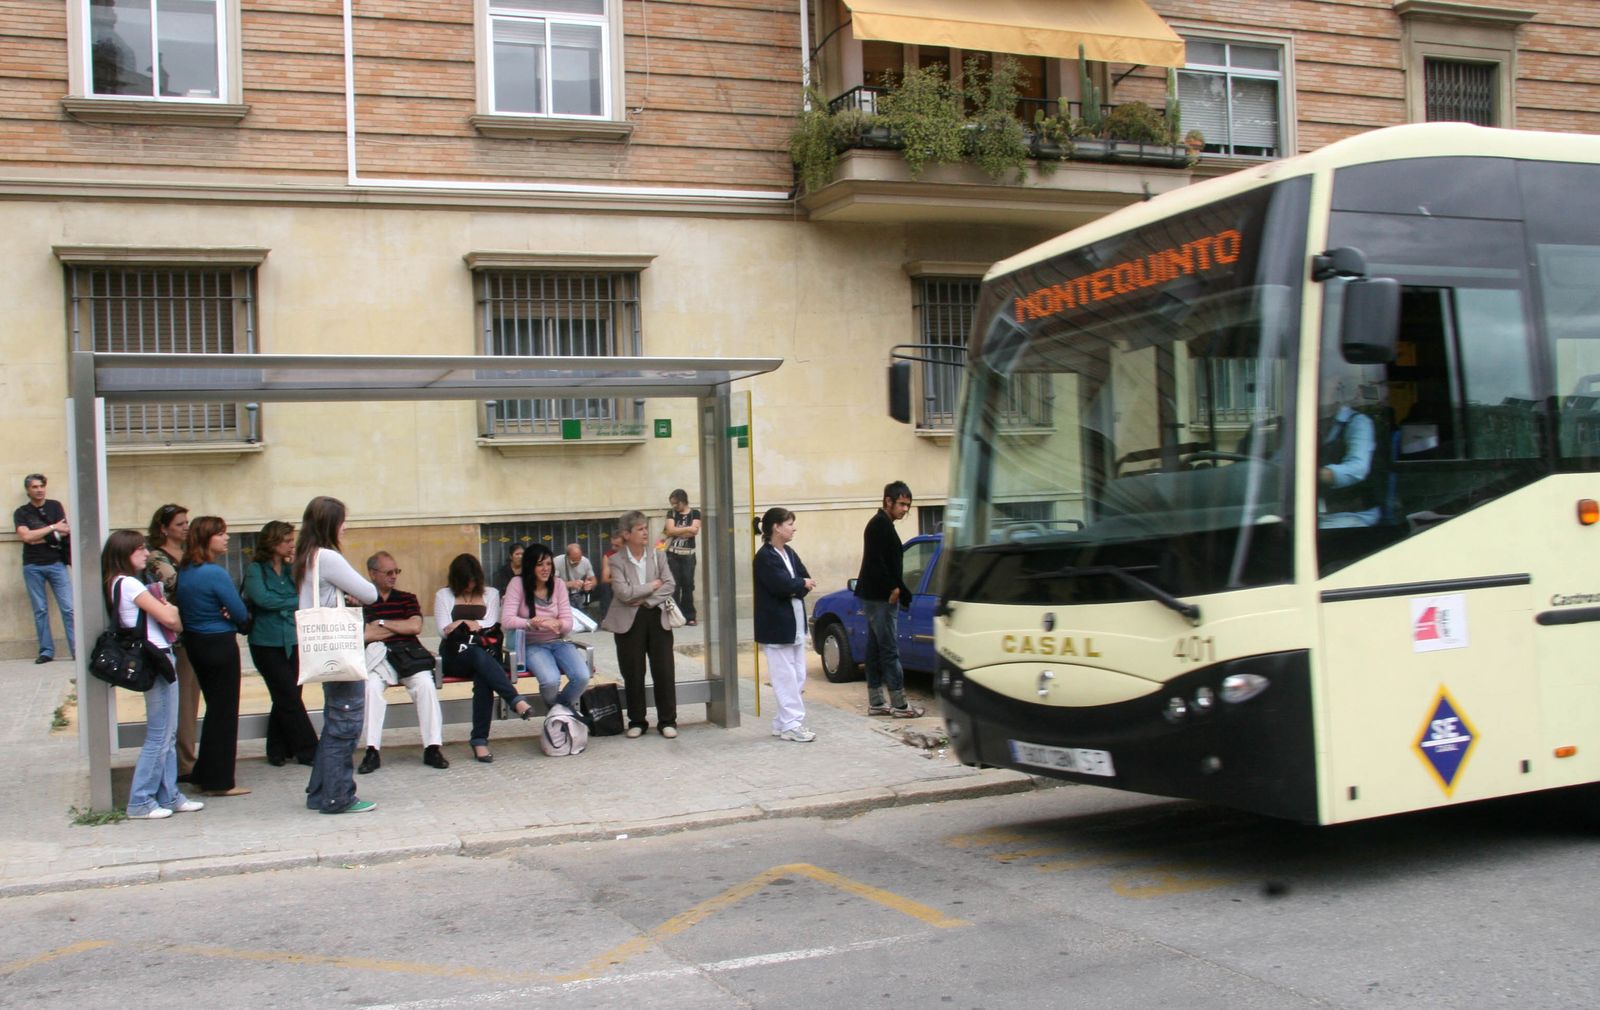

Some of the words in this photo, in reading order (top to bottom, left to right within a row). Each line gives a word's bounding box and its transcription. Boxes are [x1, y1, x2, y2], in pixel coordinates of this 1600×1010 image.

[1015, 229, 1242, 324] MONTEQUINTO
[348, 623, 357, 632] ES
[303, 643, 312, 653] LO
[313, 643, 328, 652] QUE
[329, 641, 357, 651] QUIERES
[1001, 634, 1102, 658] CASAL
[1173, 635, 1216, 663] 401
